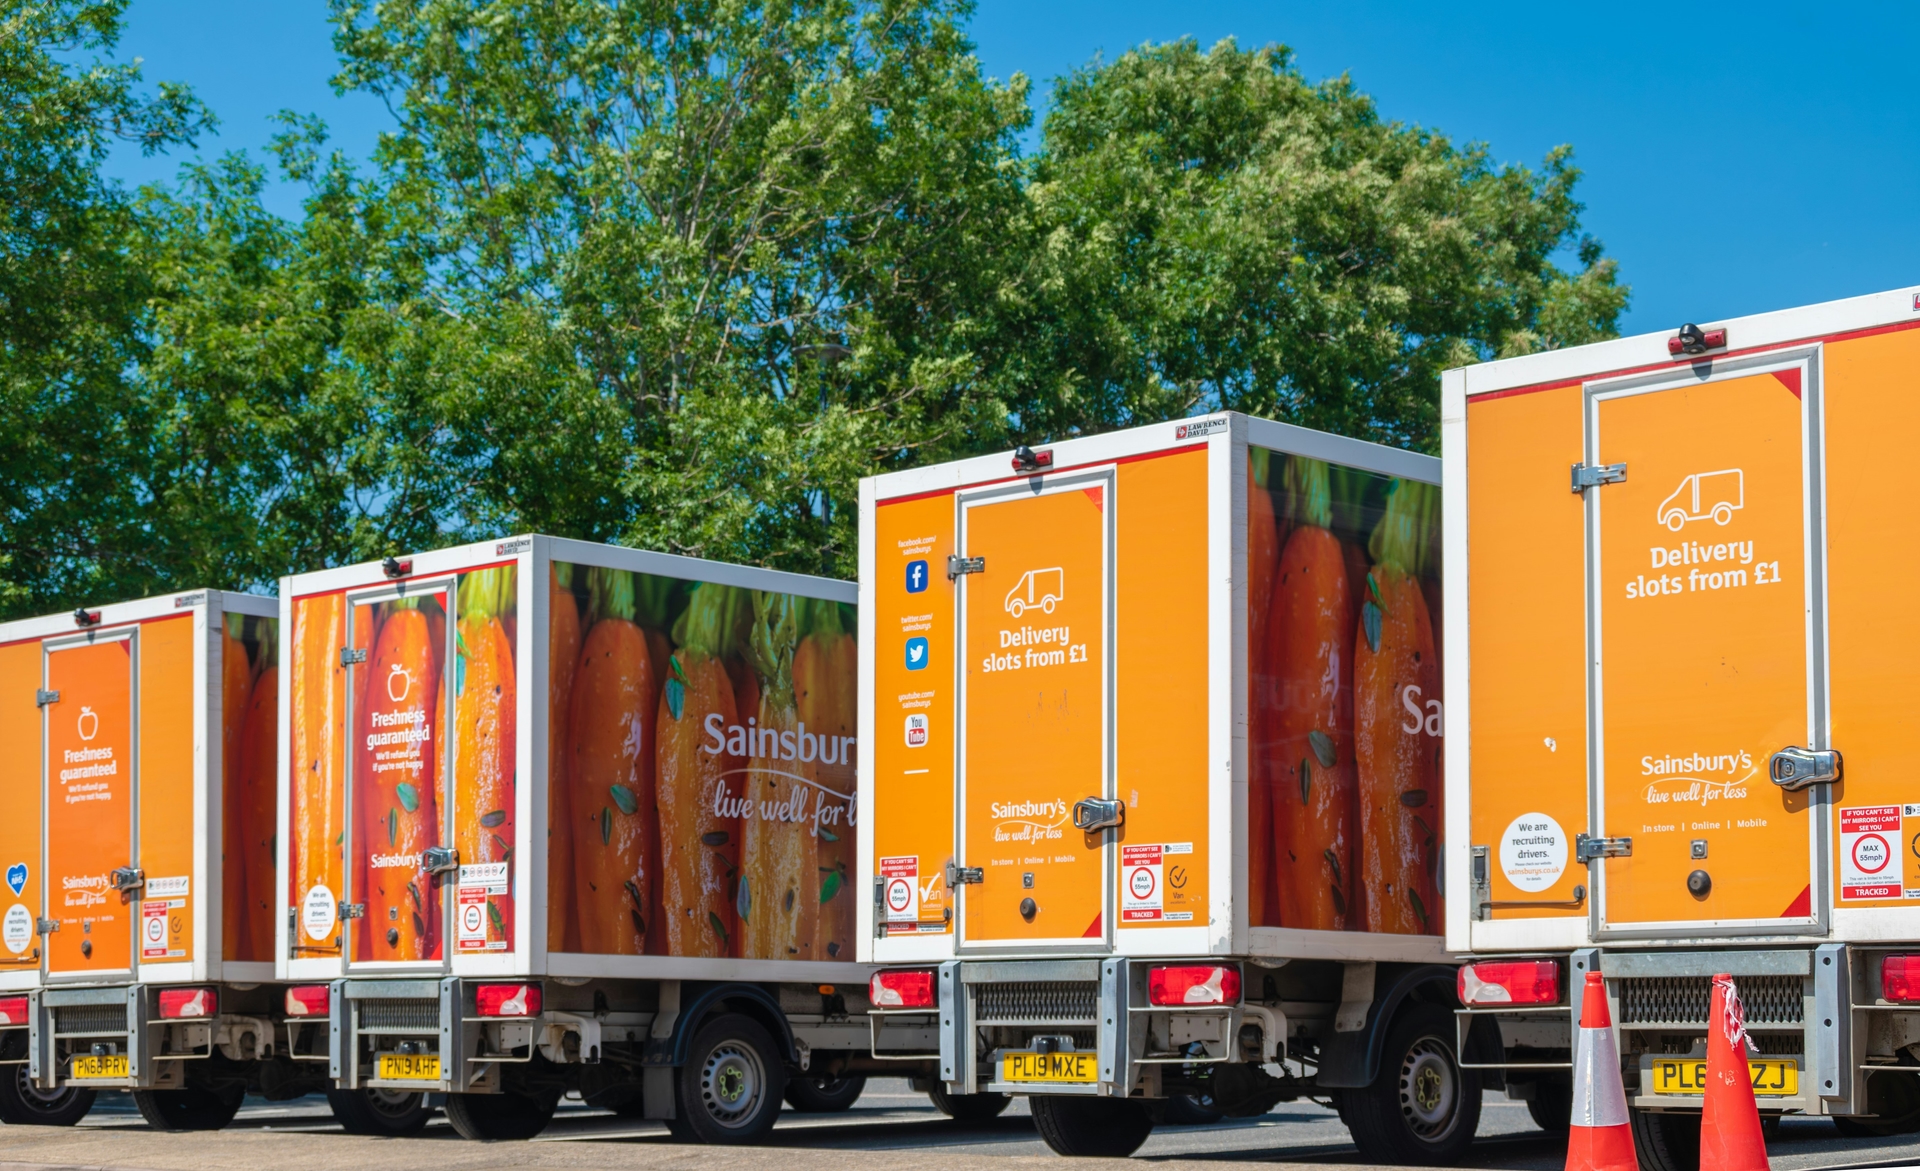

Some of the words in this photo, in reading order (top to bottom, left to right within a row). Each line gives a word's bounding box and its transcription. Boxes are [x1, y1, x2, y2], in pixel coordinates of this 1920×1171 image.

[1187, 429, 1209, 438] DAVID
[1188, 419, 1227, 430] LAWRENCE
[1650, 540, 1753, 569] Delivery
[1625, 574, 1683, 599] slots
[1688, 568, 1747, 592] from
[1754, 560, 1782, 585] £1
[901, 612, 934, 624] twitter.com/
[999, 626, 1070, 648] Delivery
[982, 652, 1022, 673] slots
[1025, 648, 1065, 668] from
[1069, 643, 1088, 663] £1
[898, 690, 936, 702] youtube.com/
[371, 709, 426, 728] Freshness
[911, 716, 923, 728] You
[366, 724, 431, 751] guaranteed
[704, 713, 858, 765] Sainsbur
[909, 730, 925, 743] Tube
[63, 746, 113, 764] Freshness
[1641, 749, 1752, 776] Sainsbury's
[60, 759, 117, 785] guaranteed
[1647, 785, 1670, 804] live
[1672, 782, 1701, 802] well
[1701, 783, 1722, 807] for
[1723, 781, 1747, 799] less
[714, 779, 754, 819] live
[758, 784, 808, 823] well
[809, 791, 844, 837] for
[991, 798, 1066, 819] Sainsbury's
[1518, 823, 1533, 832] We
[1534, 823, 1548, 831] are
[1642, 825, 1653, 833] In
[1653, 824, 1675, 832] store
[1691, 821, 1720, 830] Online
[1737, 818, 1767, 828] Mobile
[1881, 815, 1899, 823] CAN'T
[994, 826, 1011, 842] live
[1011, 824, 1031, 841] well
[1030, 825, 1046, 845] for
[1045, 823, 1063, 839] less
[1512, 835, 1555, 847] recruiting
[371, 851, 423, 869] Sainsbury's
[1054, 855, 1076, 863] Mobile
[1517, 849, 1550, 859] drivers.
[1859, 854, 1883, 862] 55mph
[11, 875, 24, 885] NHS
[1508, 866, 1560, 876] sainsburys.co.uk
[1855, 888, 1889, 896] TRACKED
[105, 1058, 128, 1074] PRV
[386, 1057, 412, 1075] PN19
[415, 1058, 438, 1075] AHF
[1013, 1056, 1047, 1077] PL19
[1052, 1056, 1087, 1077] MXE
[1662, 1063, 1706, 1088] PL6
[1751, 1063, 1785, 1089] ZJ
